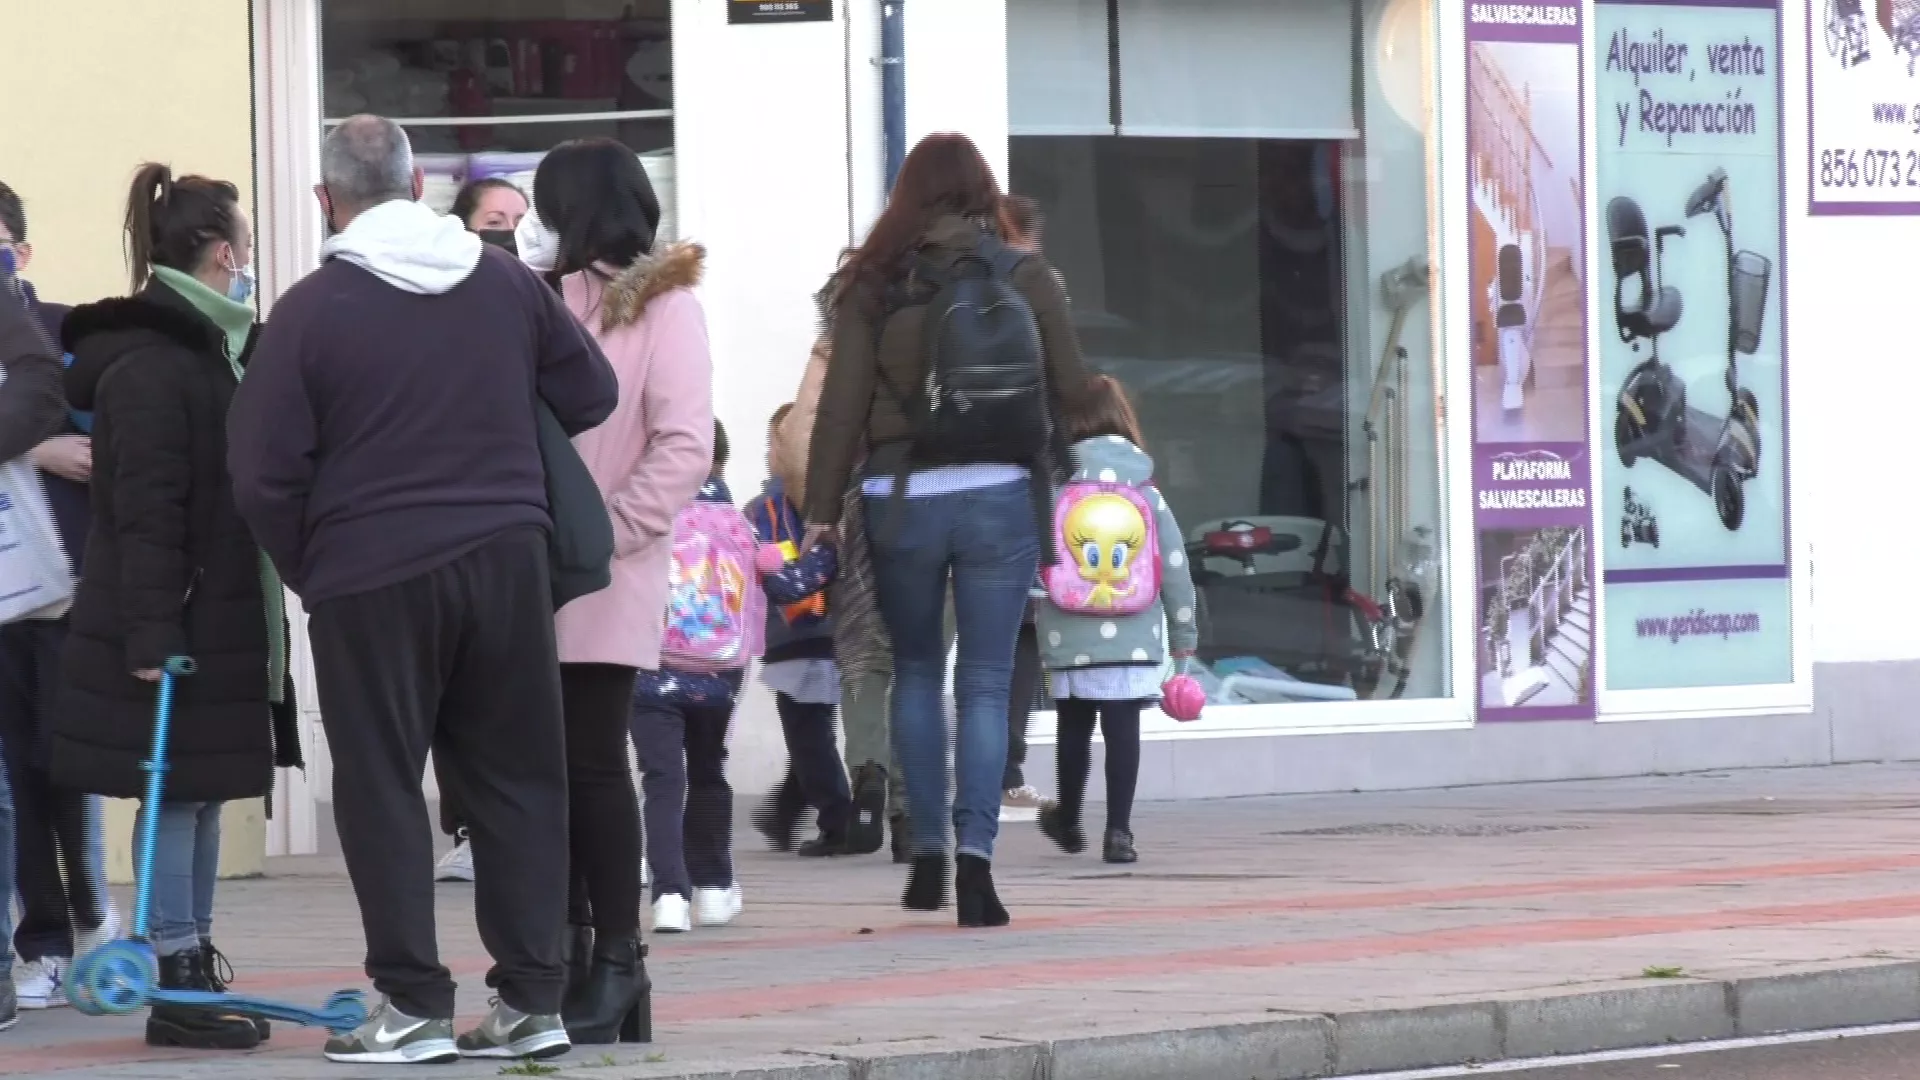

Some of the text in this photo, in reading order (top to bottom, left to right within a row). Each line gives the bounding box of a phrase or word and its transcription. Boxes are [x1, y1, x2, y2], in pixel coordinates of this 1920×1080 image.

[1471, 3, 1577, 25] SALVAESCALERAS
[1605, 27, 1765, 86] Alquiler, venta
[1616, 87, 1756, 147] y Reparación
[1821, 149, 1920, 187] 856 073 2
[1492, 460, 1571, 480] PLATAFORMA
[1479, 488, 1586, 509] SALVAESCALERAS
[1634, 608, 1760, 644] www.geridiscap.com
